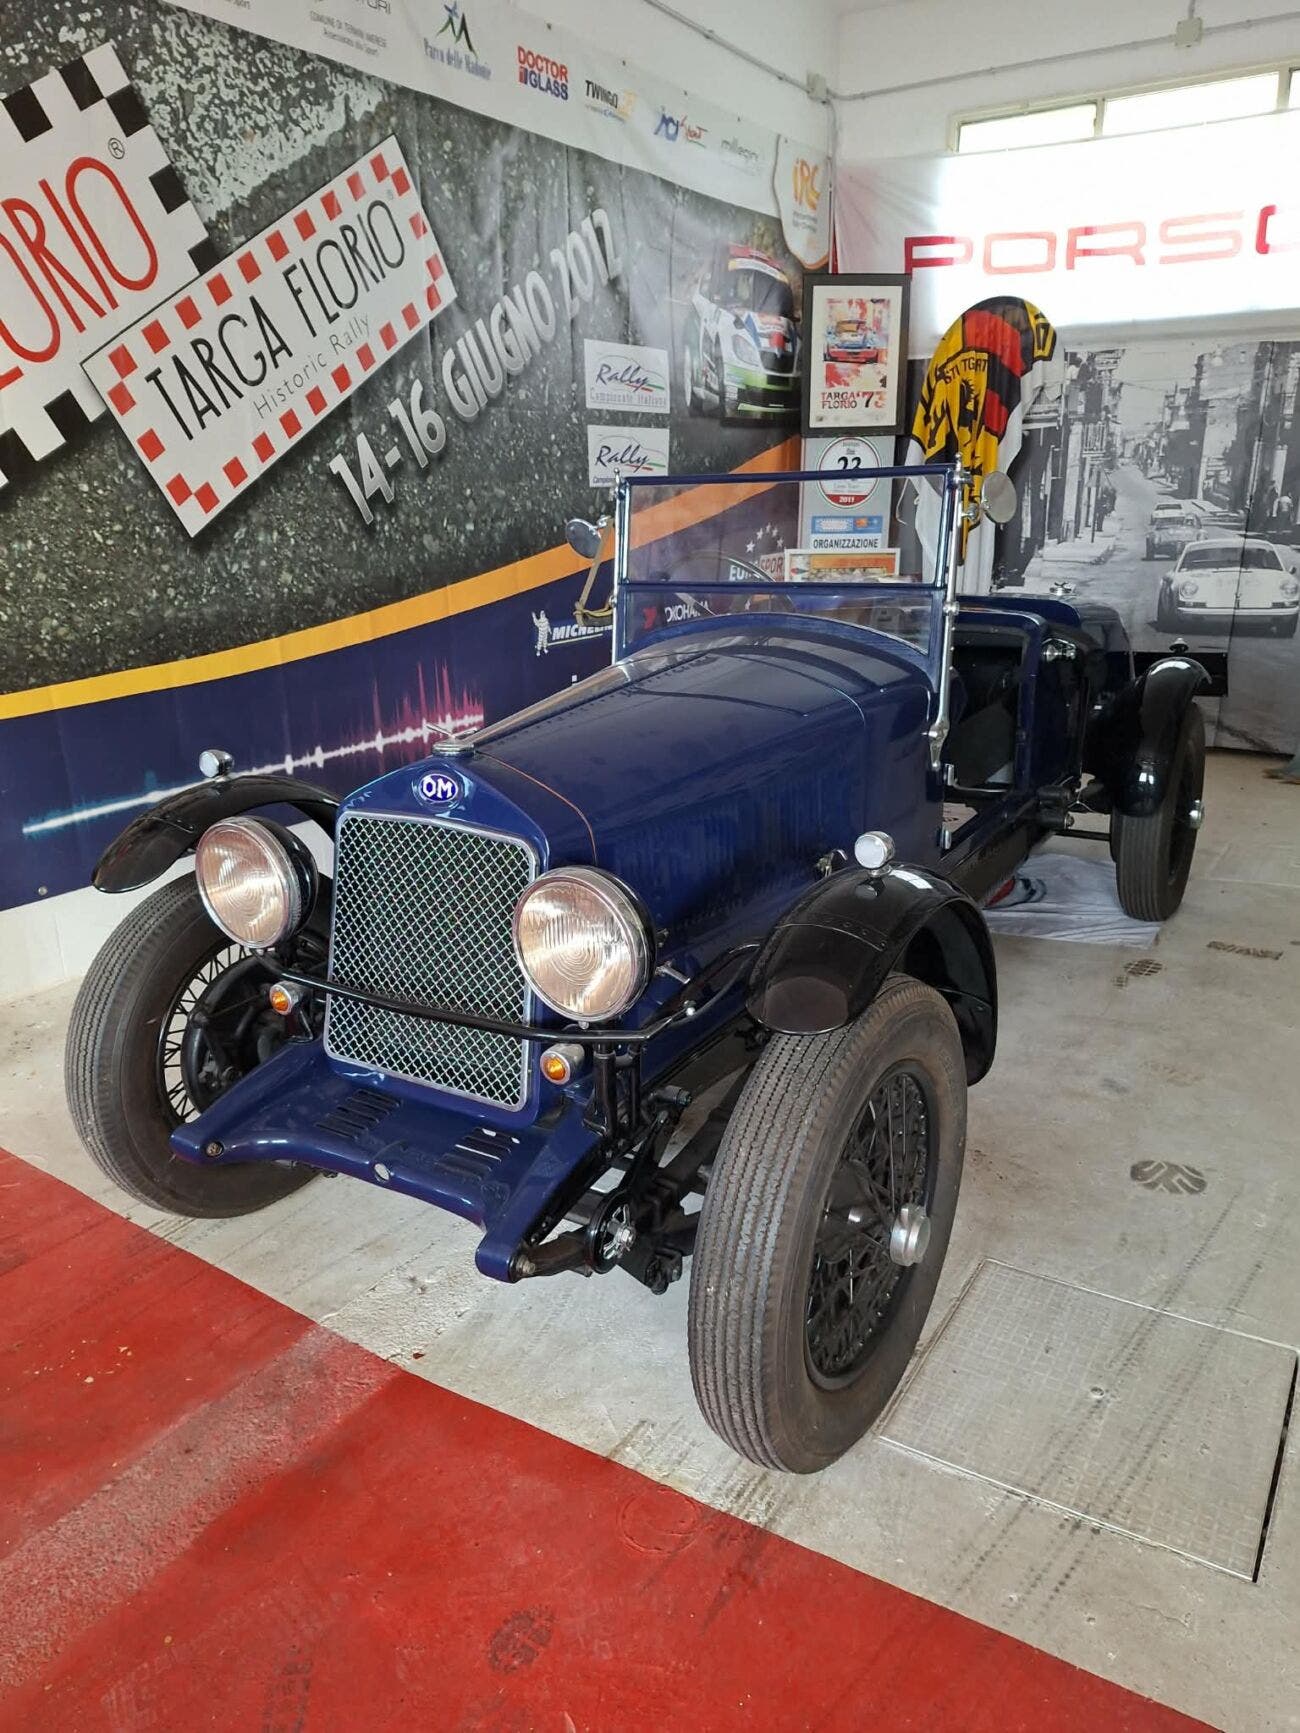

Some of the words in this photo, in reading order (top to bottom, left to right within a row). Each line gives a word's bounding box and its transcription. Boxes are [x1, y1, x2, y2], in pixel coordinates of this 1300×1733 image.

[517, 45, 569, 83] DOCTOR
[528, 68, 569, 101] GLASS
[585, 79, 619, 109] TWINGO
[144, 296, 293, 441] TARGA
[282, 199, 405, 338] FLORIO
[252, 353, 328, 419] Historic
[328, 313, 372, 361] Rally
[595, 363, 650, 393] Rally
[328, 378, 447, 526] 14-16
[441, 270, 557, 419] GIUGNO
[821, 391, 856, 401] TARGA
[821, 400, 858, 409] FLORIO
[594, 443, 649, 473] Rally
[813, 538, 879, 550] ORGANIZZAZIONE
[422, 774, 454, 799] OM
